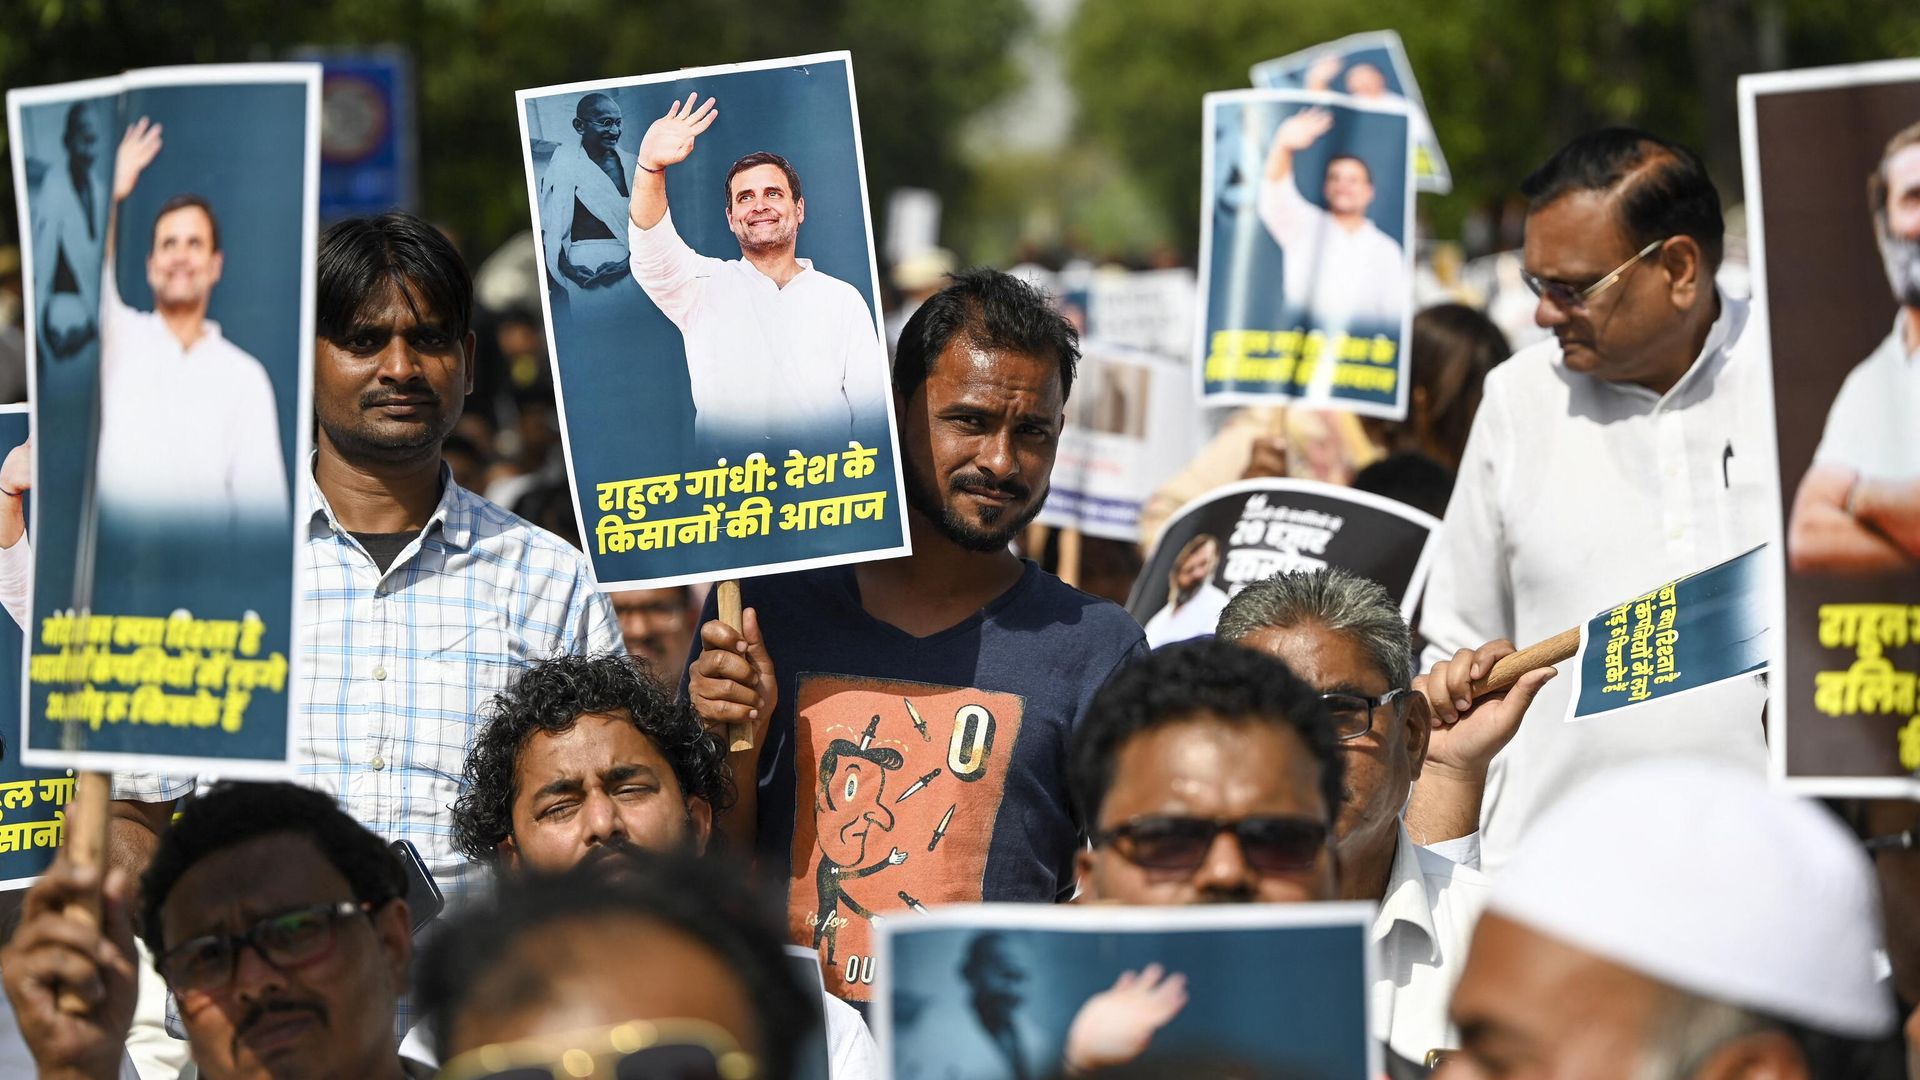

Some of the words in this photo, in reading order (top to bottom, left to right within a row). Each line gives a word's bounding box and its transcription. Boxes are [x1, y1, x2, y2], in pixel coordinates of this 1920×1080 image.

[596, 473, 680, 520] राहुल
[685, 453, 777, 498] गांधी:
[784, 449, 837, 488] देश
[842, 441, 878, 479] के
[596, 502, 725, 555] किसानों
[725, 496, 773, 538] की
[779, 491, 887, 531] आवाज
[1631, 659, 1654, 677] में
[1653, 671, 1682, 684] है
[1627, 675, 1652, 701] लगे
[804, 911, 821, 927] is
[820, 909, 849, 932] for
